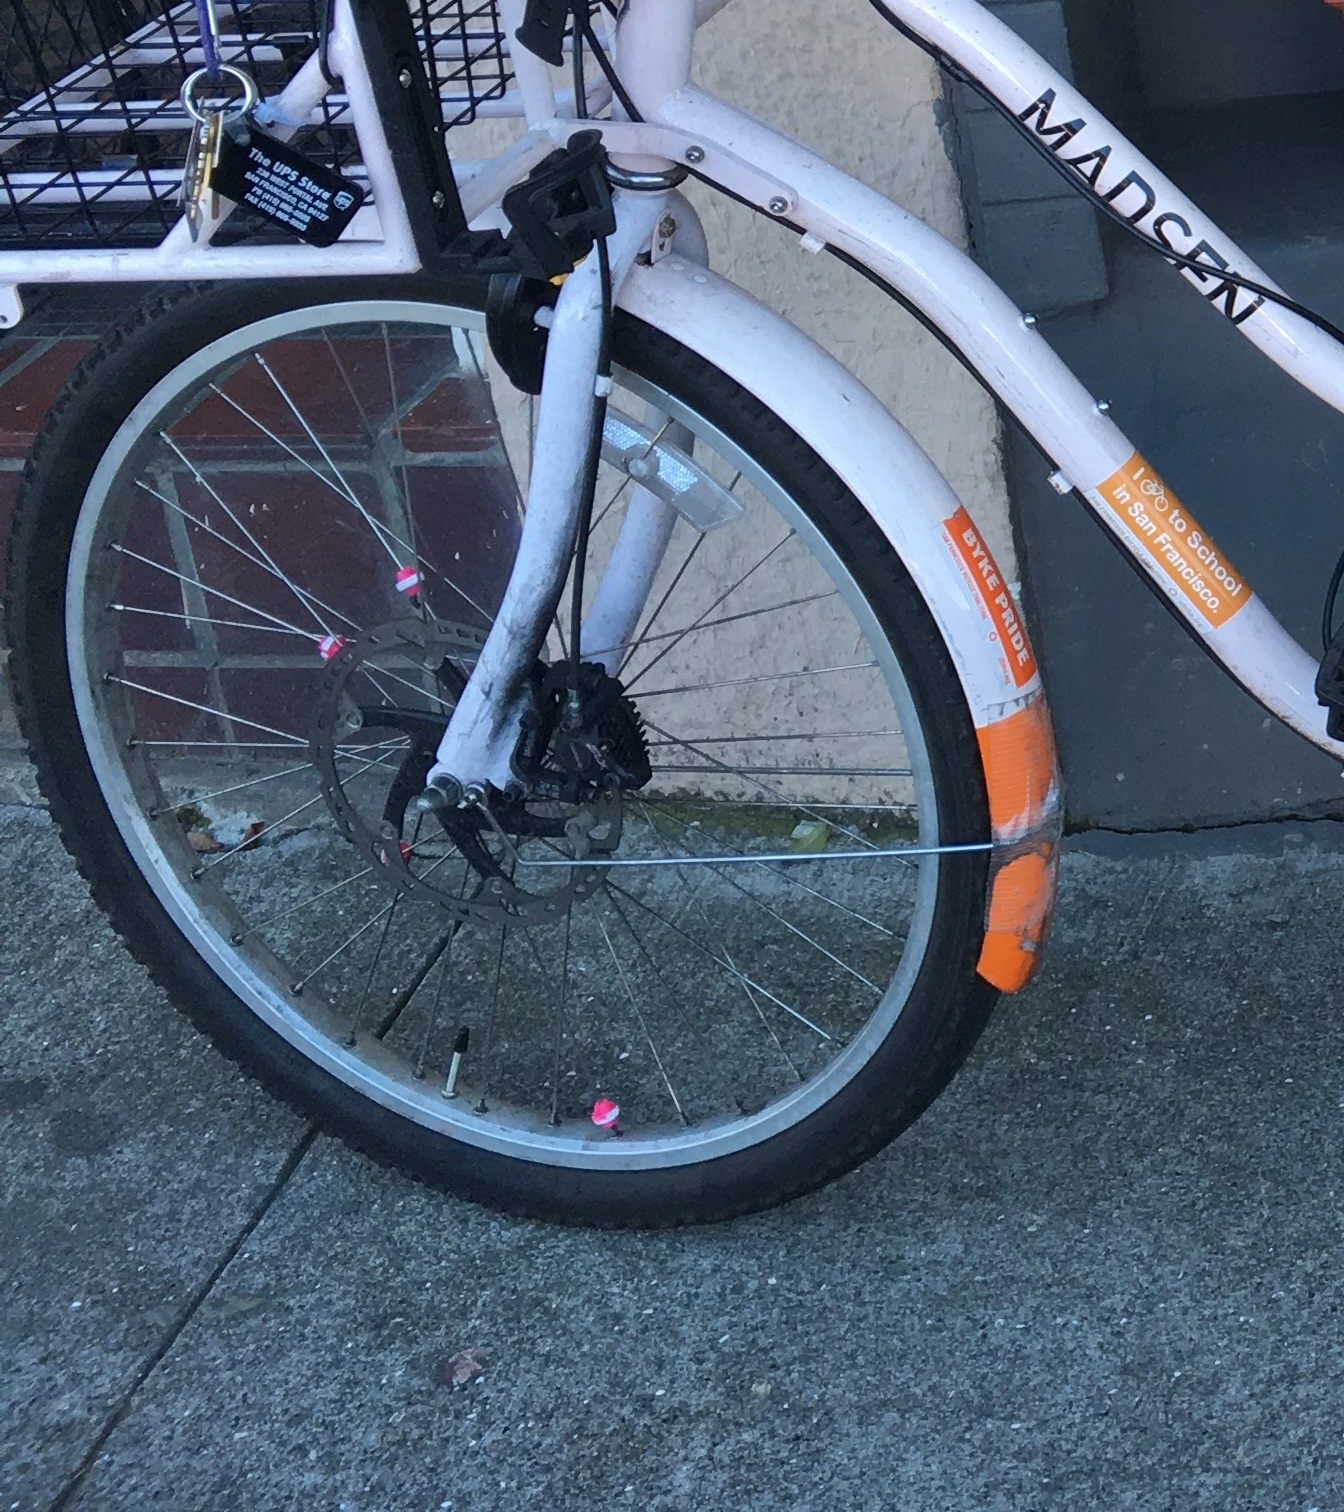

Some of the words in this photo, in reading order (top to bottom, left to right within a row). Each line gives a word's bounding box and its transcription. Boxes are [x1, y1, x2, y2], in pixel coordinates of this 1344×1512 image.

[249, 148, 271, 166] The
[272, 161, 299, 180] UPS
[300, 176, 332, 199] Store
[1018, 88, 1266, 325] MADSEN
[960, 527, 1000, 591] BYKE
[994, 591, 1031, 666] PRIDE
[1112, 484, 1130, 504] in
[1127, 501, 1157, 536] San
[1153, 535, 1222, 614] Francisco.
[1133, 467, 1145, 479] I
[1168, 509, 1187, 532] to
[1187, 533, 1243, 596] School
